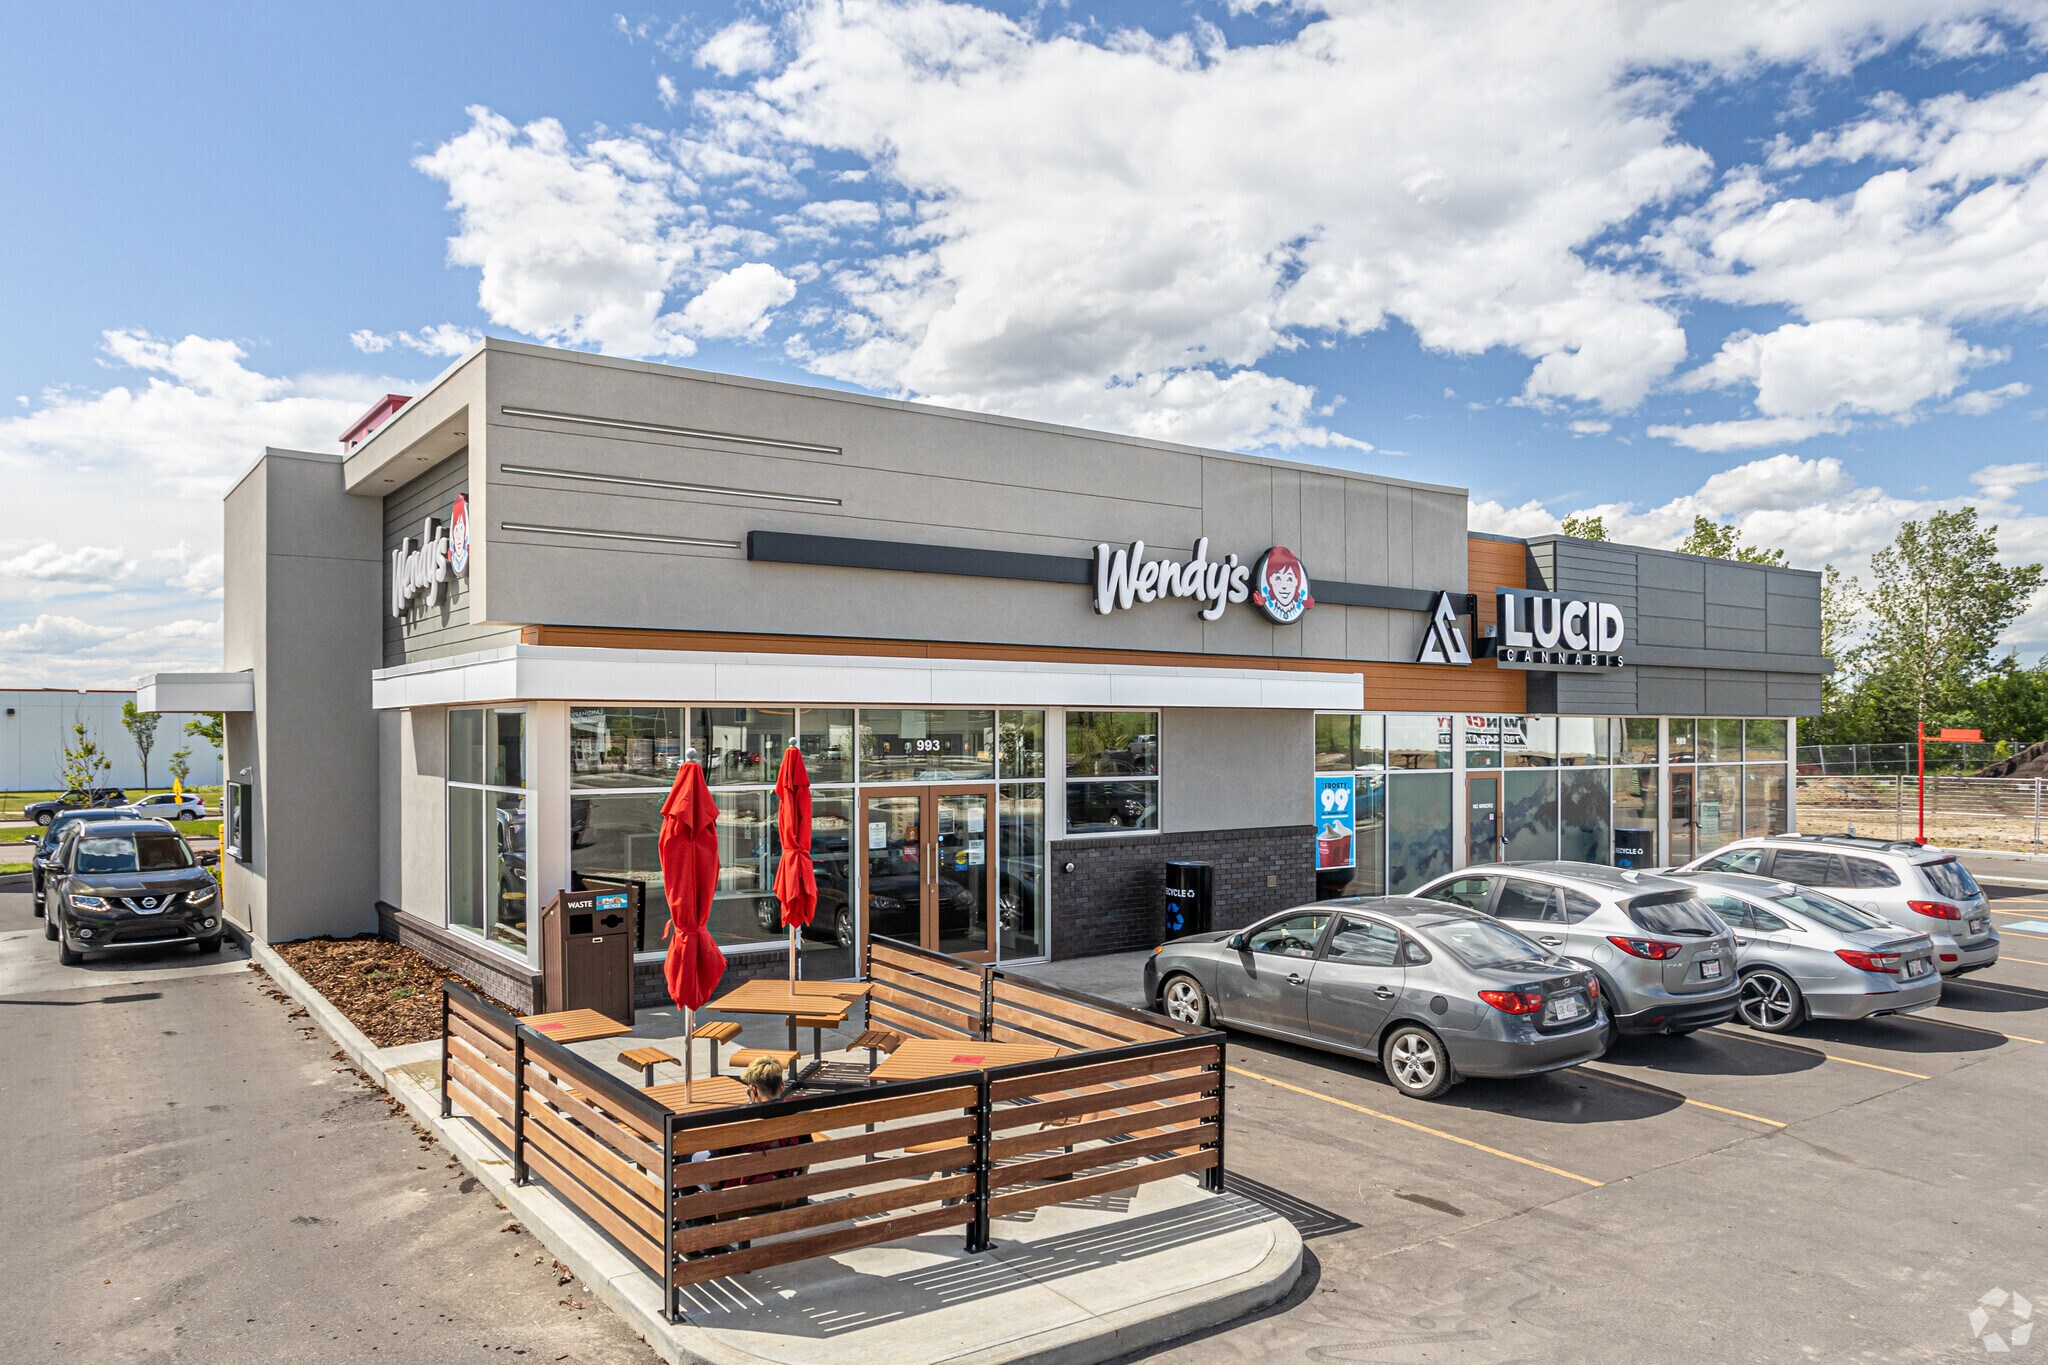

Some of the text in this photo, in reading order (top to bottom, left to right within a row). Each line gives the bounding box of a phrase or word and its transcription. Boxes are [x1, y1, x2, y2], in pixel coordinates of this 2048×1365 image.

[392, 516, 447, 618] Wendy's
[1095, 537, 1250, 621] Wendy's
[1503, 593, 1625, 652] LUCID
[1506, 648, 1624, 667] CANNABIS
[916, 739, 941, 751] 993
[1165, 887, 1187, 898] ECYCLE
[567, 900, 593, 909] WASTE
